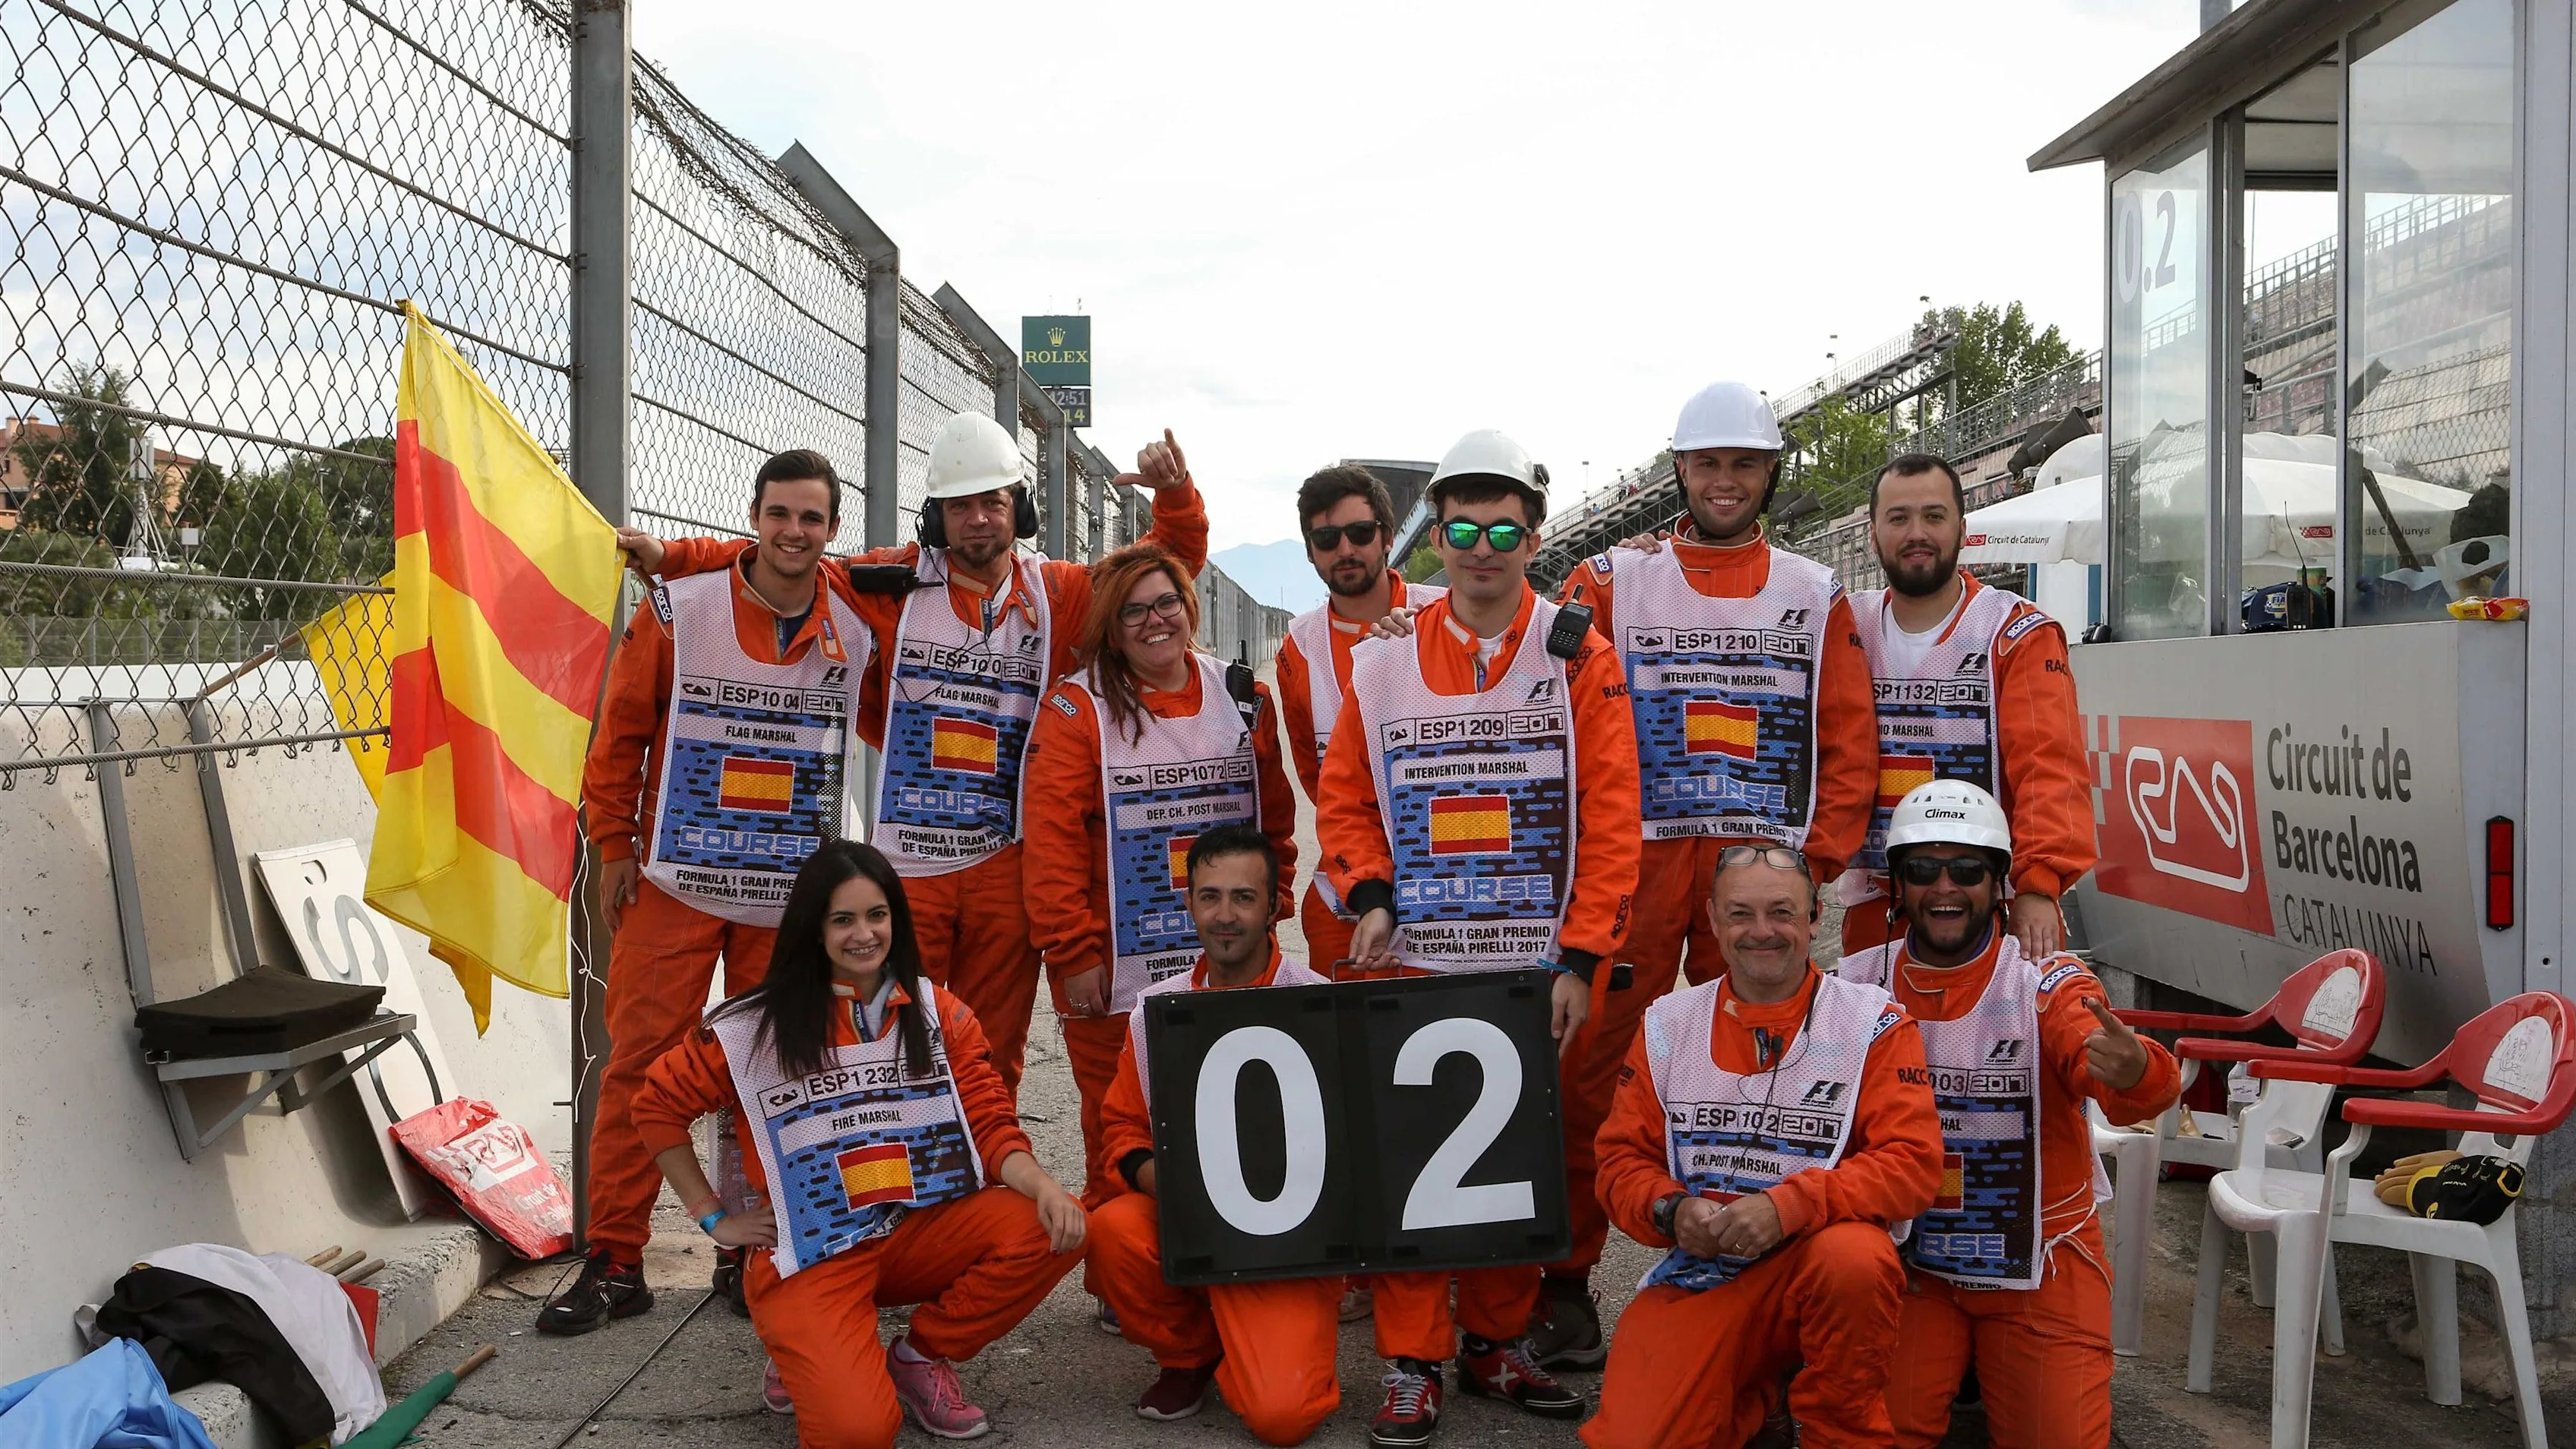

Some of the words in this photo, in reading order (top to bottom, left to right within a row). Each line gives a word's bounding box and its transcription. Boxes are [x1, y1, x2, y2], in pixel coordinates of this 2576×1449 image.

[1025, 351, 1088, 363] ROLEX
[653, 588, 673, 621] sparco
[2006, 612, 2046, 638] sparco
[1764, 635, 1810, 654] 2017
[1661, 671, 1728, 685] INTERVENTION
[1732, 674, 1778, 687] MARSHAL
[935, 687, 958, 700] FLAG
[961, 692, 999, 709] MARSHAL
[1874, 683, 1935, 700] SP1132
[1939, 684, 1988, 702] 2017
[1051, 693, 1076, 716] sparco
[1511, 712, 1563, 734] 2017
[1892, 724, 1935, 737] MARSHAL
[725, 725, 750, 738] FLAG
[753, 729, 797, 743] MARSHAL
[1405, 762, 1475, 780] INTERVENTION
[1478, 760, 1529, 775] MARSHAL
[2267, 722, 2366, 799] Circuit
[2371, 727, 2413, 803] de
[1154, 765, 1225, 785] ESP1072
[1652, 775, 1786, 809] COURSE
[1147, 809, 1167, 821] DEP.
[1168, 807, 1185, 819] CH.
[1188, 804, 1212, 816] POST
[1213, 800, 1241, 814] MARSHAL
[1924, 808, 1965, 820] Climax
[898, 829, 946, 844] FORMULA
[949, 836, 954, 844] 1
[957, 835, 986, 846] GRAN
[1656, 823, 1709, 838] FORMULA
[1712, 824, 1717, 834] 1
[1722, 822, 1753, 835] GRAN
[679, 826, 820, 858] COURSE
[902, 843, 915, 852] DE
[918, 843, 957, 857] ESPAÑA
[959, 841, 999, 857] PIRELLI
[2272, 810, 2422, 893] Barcelona
[676, 870, 728, 886] FORMULA
[732, 876, 737, 886] 1
[740, 875, 770, 888] GRAN
[773, 878, 794, 889] PRE
[679, 882, 693, 892] DE
[696, 884, 738, 898] ESPAÑA
[741, 889, 781, 901] PIRELLI
[1397, 874, 1553, 906] COURSE
[1403, 926, 1455, 941] FORMULA
[1457, 928, 1463, 940] 1
[1466, 927, 1499, 940] GRAN
[1503, 925, 1551, 939] PREMIO
[2284, 893, 2437, 977] CATALUNYA
[1406, 942, 1420, 953] DE
[1423, 939, 1466, 955] ESPAÑA
[1470, 942, 1514, 955] PIRELLI
[1517, 941, 1547, 953] 2017
[1146, 955, 1195, 971] FORMULA
[1151, 971, 1165, 983] DE
[2040, 964, 2081, 992] sparco
[1897, 1068, 1927, 1084] RACC
[1969, 1075, 2027, 1093] 2017
[832, 1116, 856, 1132] FIRE
[858, 1110, 902, 1125] MARSHAL
[1693, 1154, 1709, 1166] CH.
[1710, 1155, 1729, 1167] POST
[1730, 1157, 1782, 1176] MARSHAL
[1919, 1234, 2006, 1257] RSE
